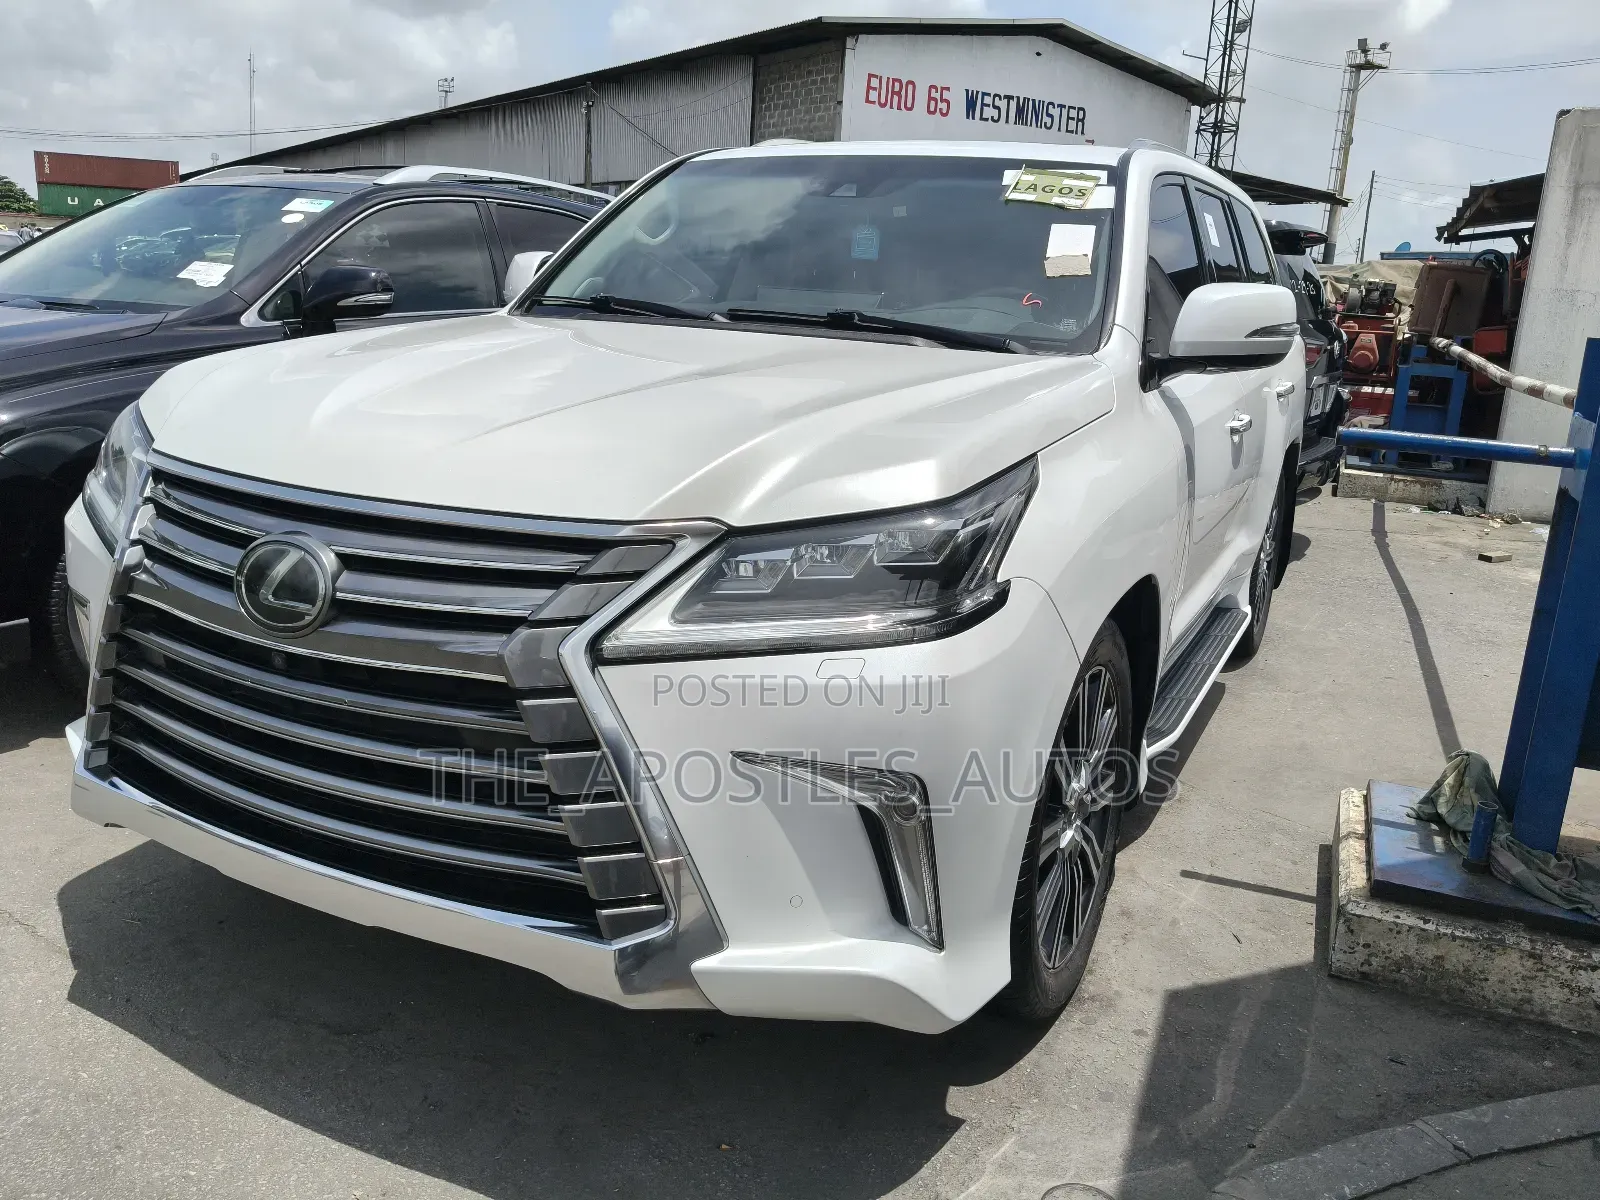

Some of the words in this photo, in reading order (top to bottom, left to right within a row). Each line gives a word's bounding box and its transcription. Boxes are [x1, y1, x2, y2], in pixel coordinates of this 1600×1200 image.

[864, 72, 917, 112] EURO
[926, 84, 951, 118] 65
[964, 88, 1087, 136] WESTMINISTER
[1012, 181, 1088, 197] LAGOS
